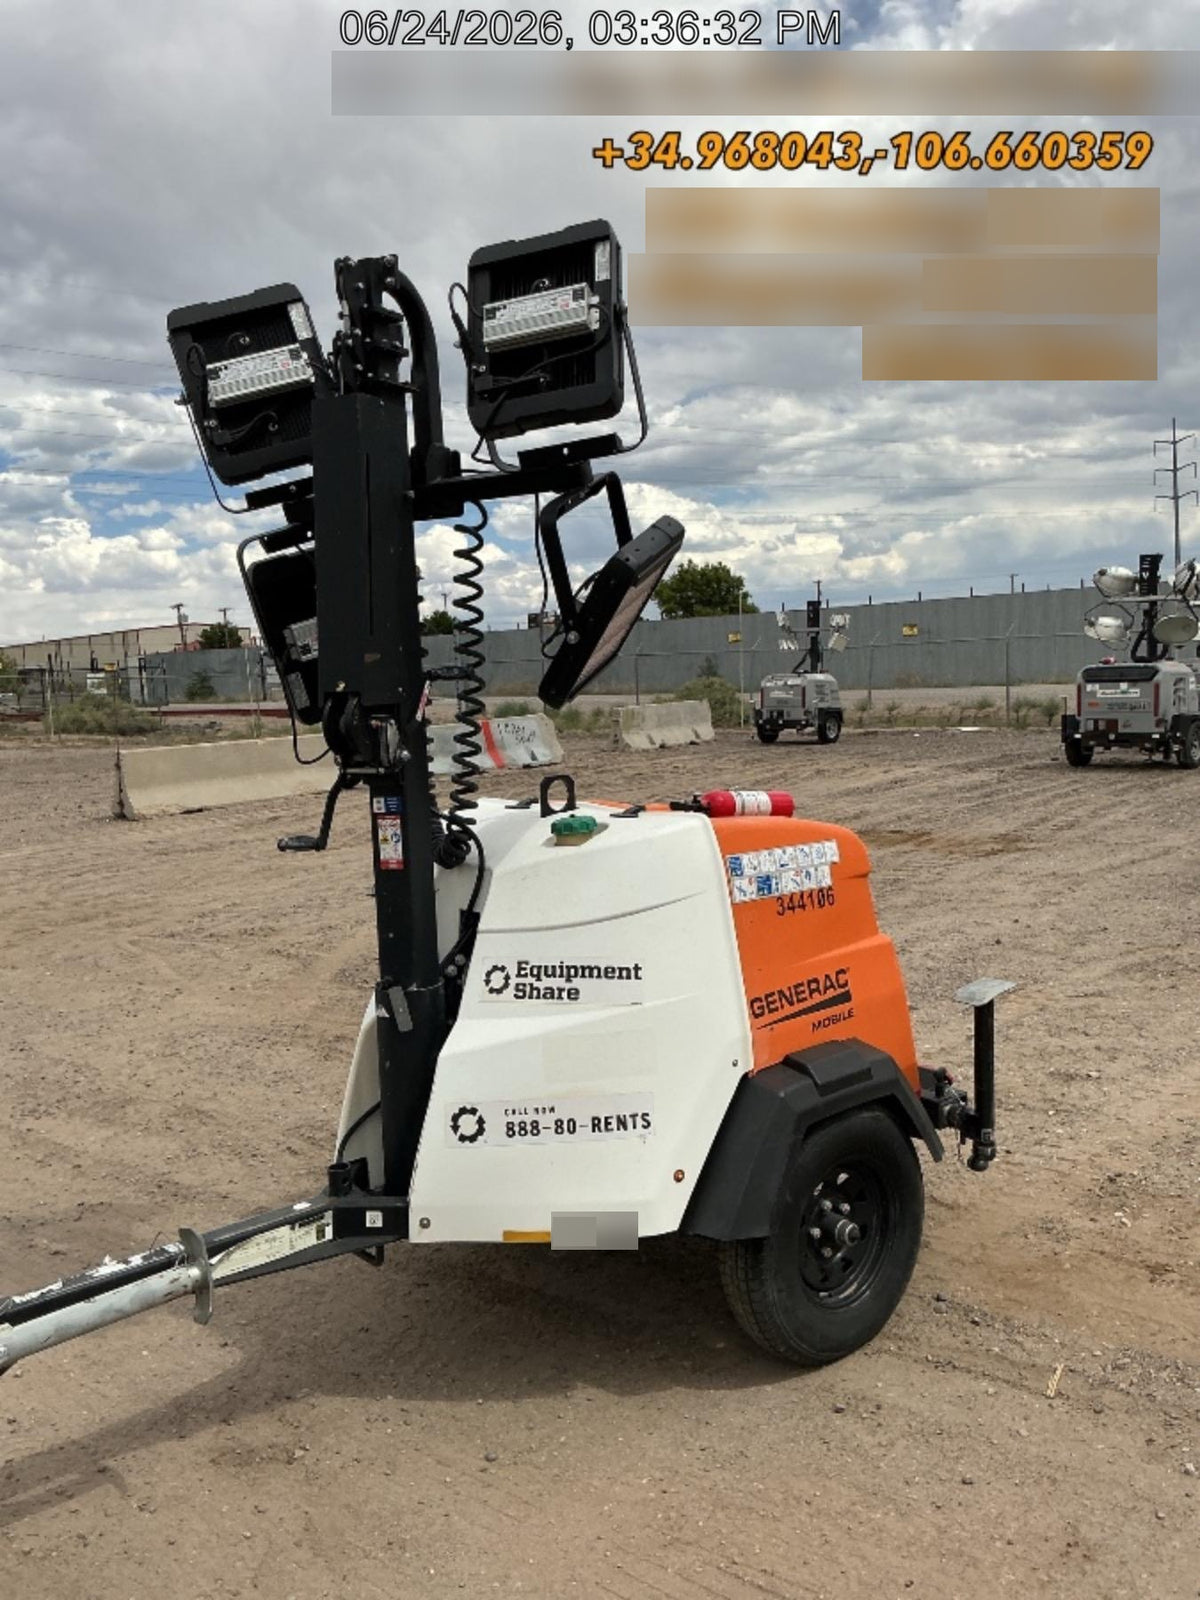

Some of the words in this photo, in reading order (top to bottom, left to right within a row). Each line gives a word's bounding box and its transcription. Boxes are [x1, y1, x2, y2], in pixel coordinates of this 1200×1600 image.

[776, 886, 836, 916] 344106
[515, 961, 642, 983] Equipment
[513, 982, 580, 1001] Share
[750, 969, 849, 1019] GENERAC
[811, 1007, 855, 1033] MOBILE
[504, 1107, 529, 1116] CALL
[505, 1113, 652, 1138] 888-80-RENTS
